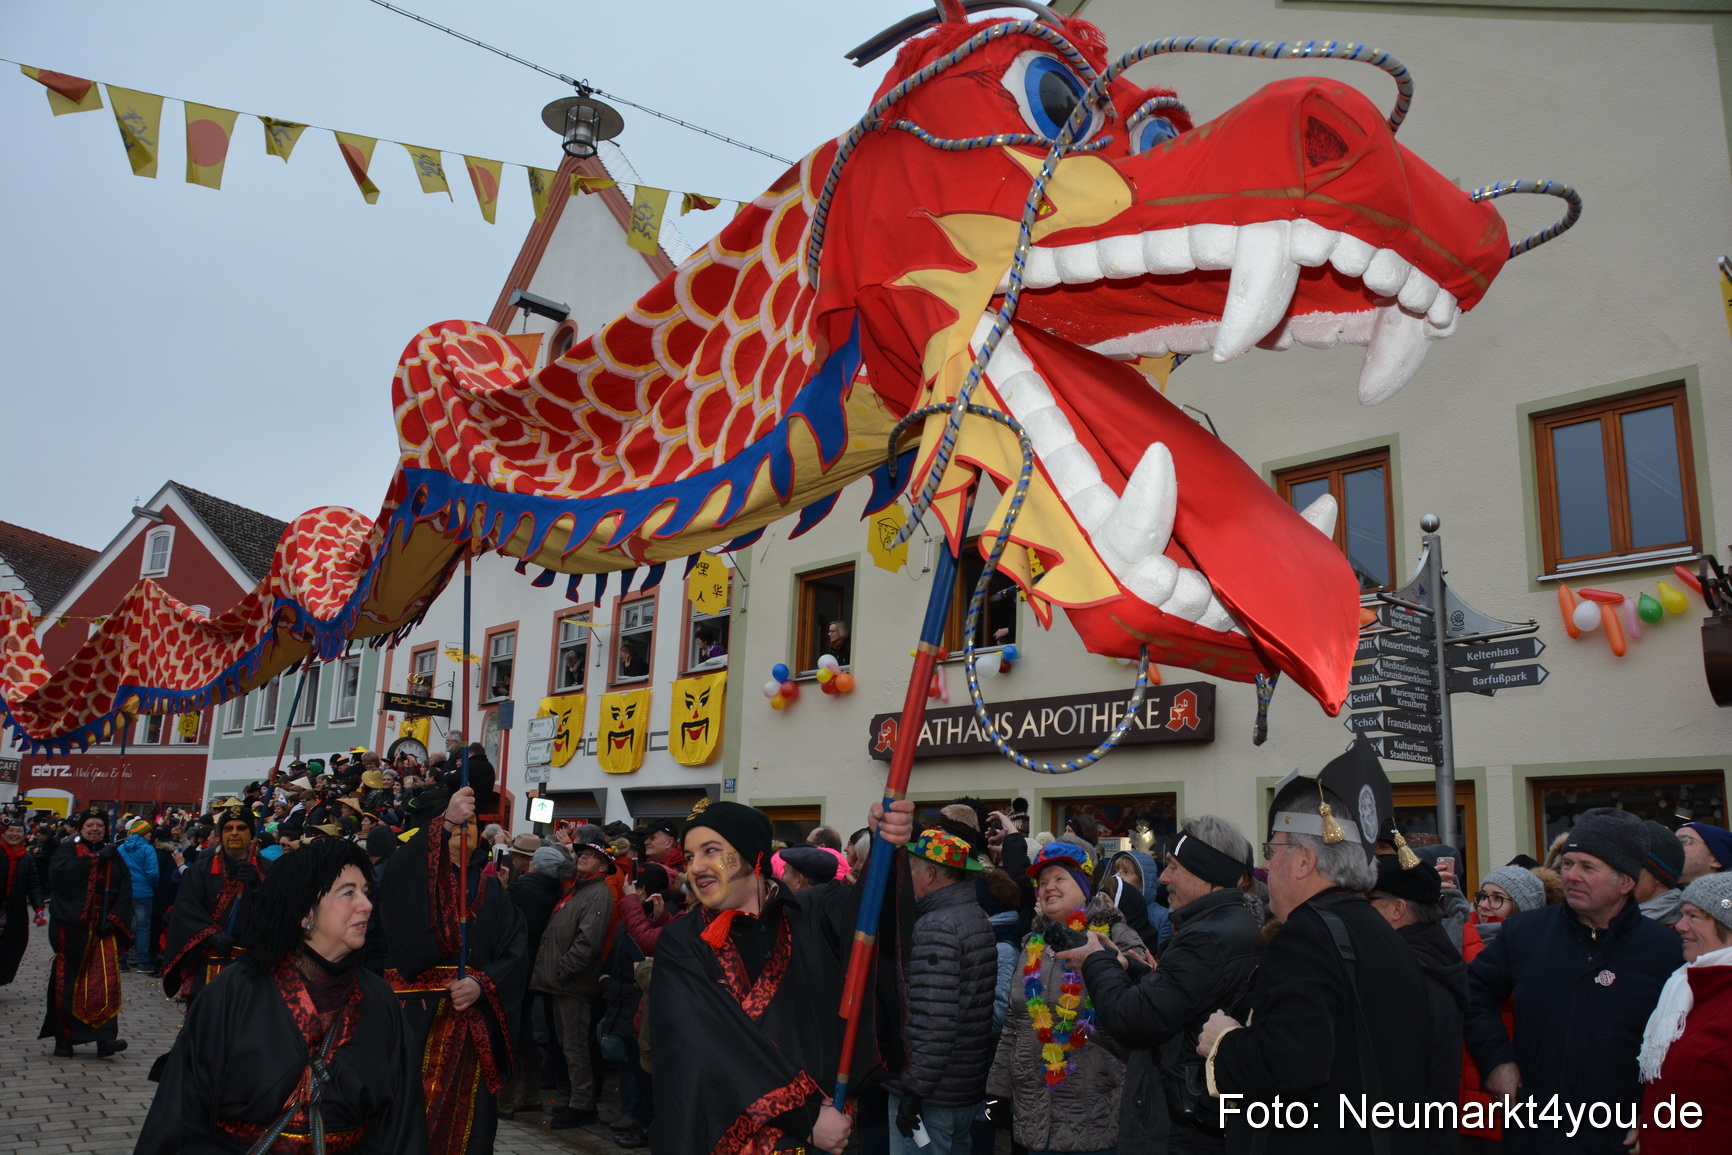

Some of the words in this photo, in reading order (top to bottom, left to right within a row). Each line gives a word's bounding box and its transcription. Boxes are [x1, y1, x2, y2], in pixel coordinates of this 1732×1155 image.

[1390, 608, 1413, 622] Museum
[1413, 614, 1422, 625] im
[1391, 619, 1421, 634] Hollerhaus
[1380, 638, 1430, 657] Wassertretanlage
[1467, 647, 1520, 661] Keltenhaus
[1382, 660, 1430, 677] Meditationshaus
[1380, 669, 1432, 686] Franziskanerkloster
[1472, 672, 1528, 686] Barfußpark
[1390, 687, 1429, 701] Mariengrotte
[1397, 697, 1427, 712] Kreuzberg
[916, 711, 1013, 747] ATHAUS
[1017, 697, 1161, 739] APOTHEKE
[1387, 716, 1433, 733] Franziskuspark
[1393, 740, 1429, 753] Kulturhaus
[1389, 749, 1433, 763] Stadtbücherei
